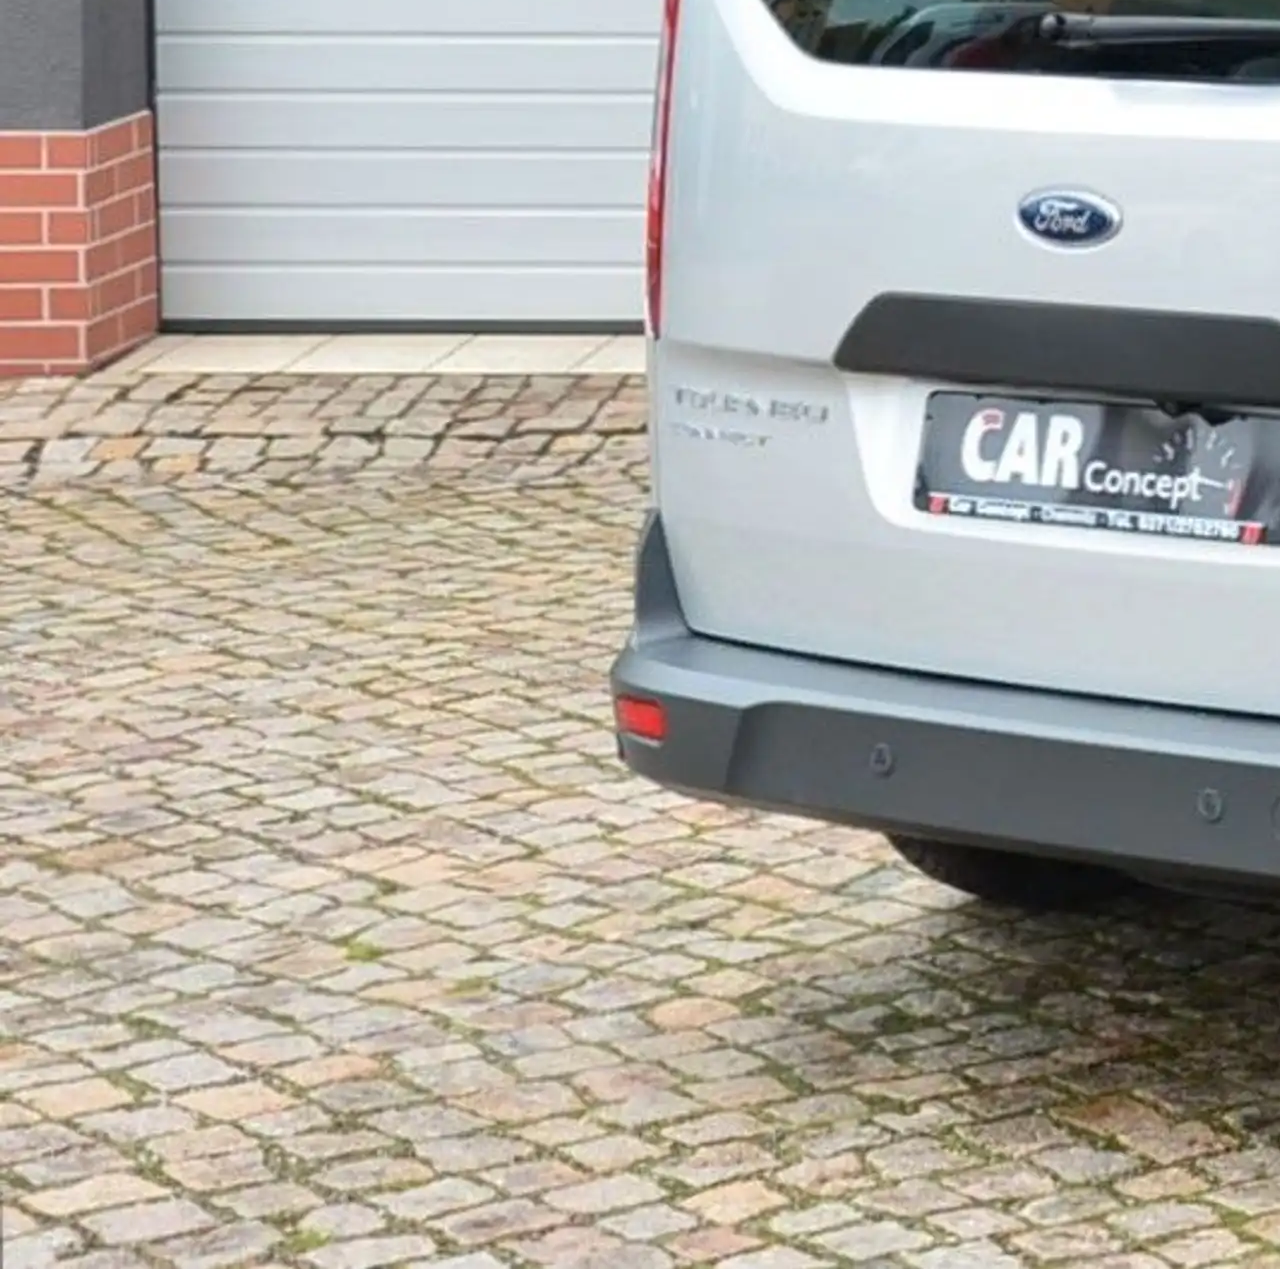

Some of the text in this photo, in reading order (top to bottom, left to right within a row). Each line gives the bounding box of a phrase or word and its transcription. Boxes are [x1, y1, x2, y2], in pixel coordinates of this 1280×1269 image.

[1034, 199, 1092, 234] Ford
[960, 407, 1204, 509] CAR Concept
